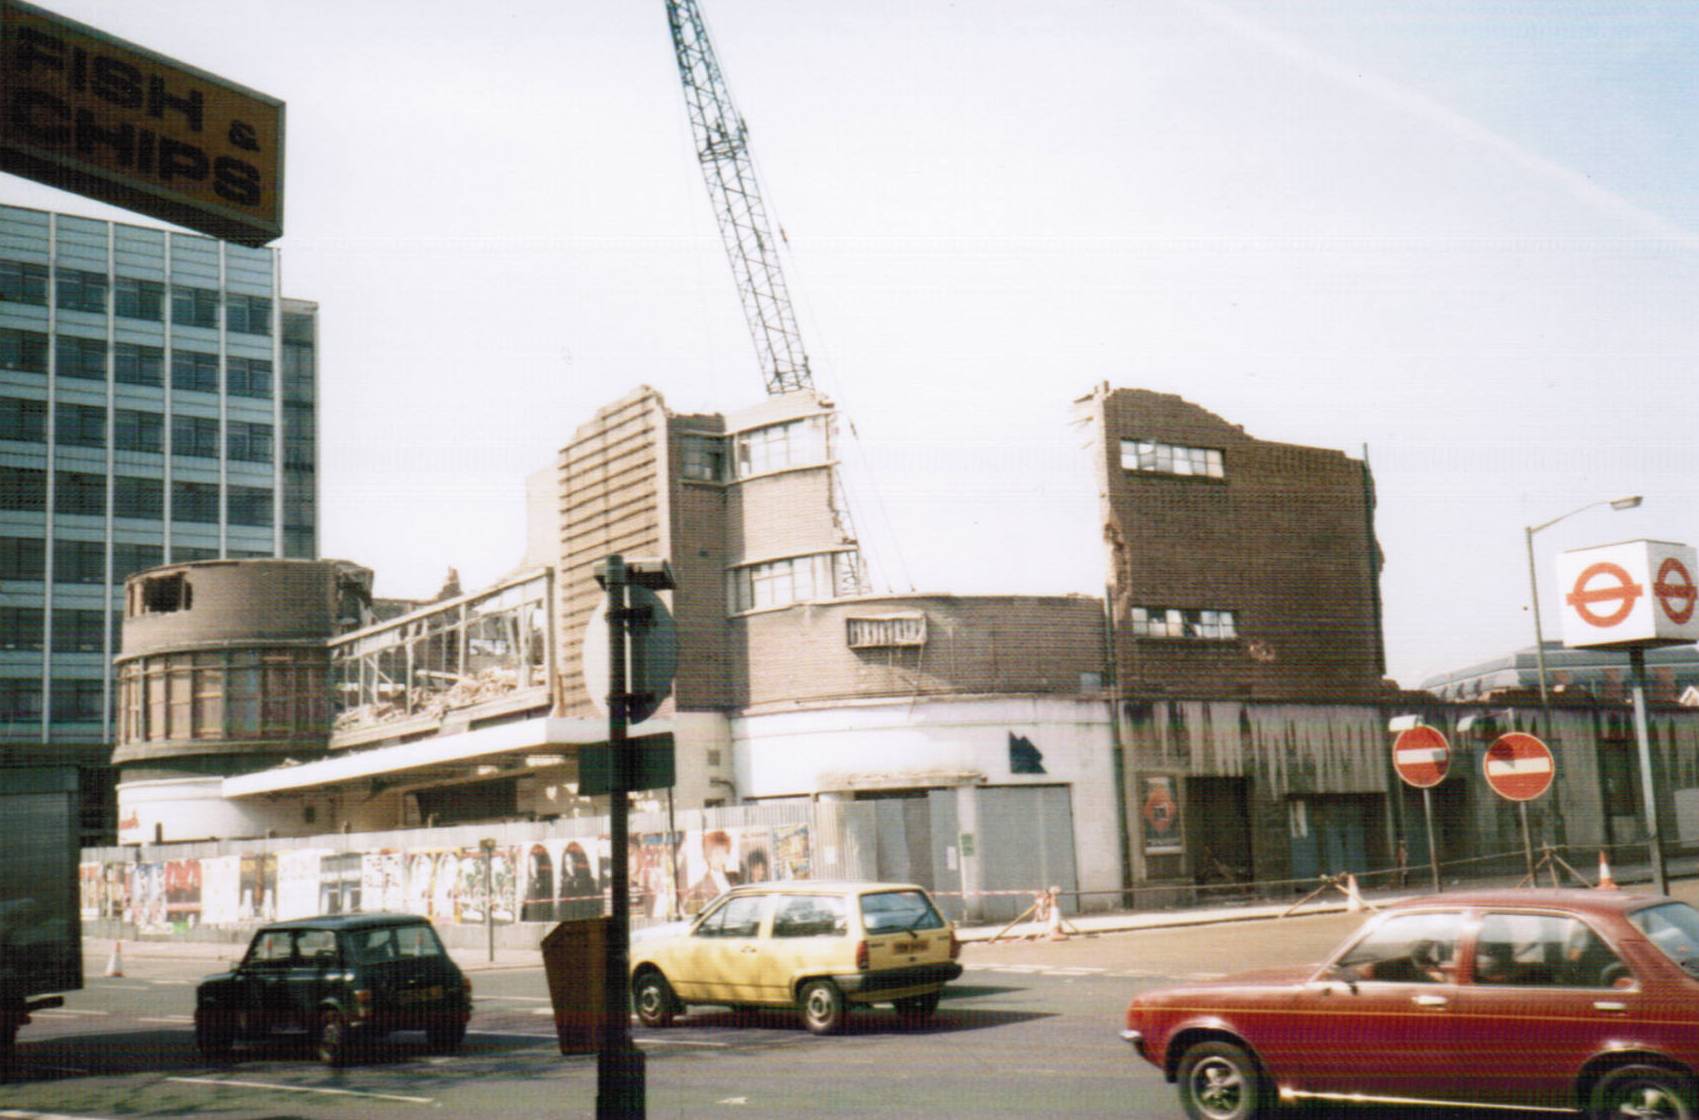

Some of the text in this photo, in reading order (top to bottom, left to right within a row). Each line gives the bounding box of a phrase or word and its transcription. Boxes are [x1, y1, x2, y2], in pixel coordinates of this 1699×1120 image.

[12, 86, 261, 207] CHIPS
[15, 26, 261, 153] FISH &
